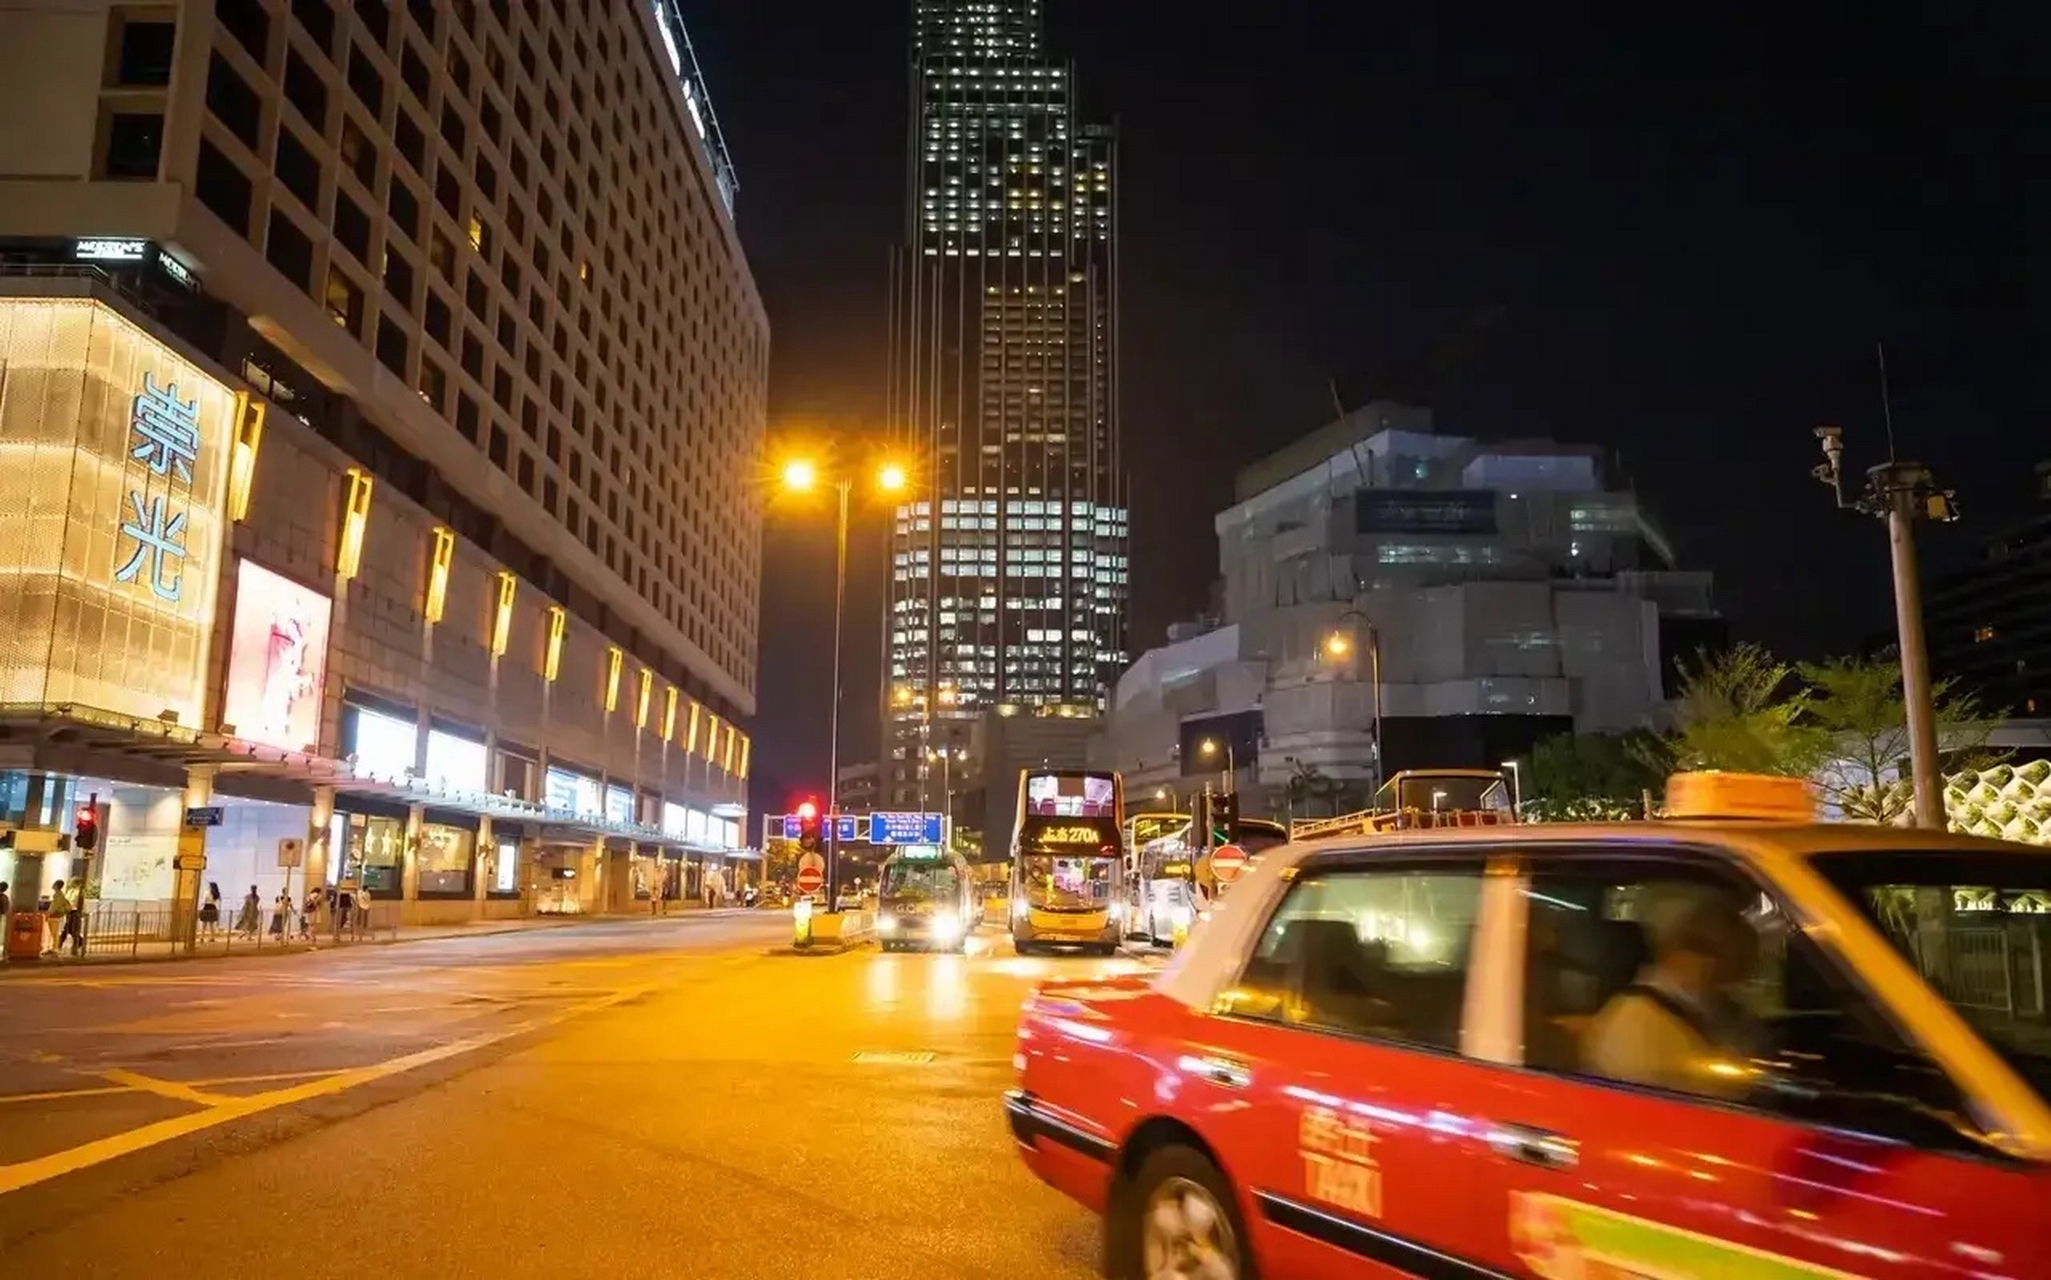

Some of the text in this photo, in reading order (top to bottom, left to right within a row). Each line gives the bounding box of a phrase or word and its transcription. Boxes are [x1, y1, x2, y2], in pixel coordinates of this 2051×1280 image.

[115, 371, 199, 602] 崇光
[1069, 827, 1099, 843] 270A
[1297, 1149, 1383, 1219] TAXI
